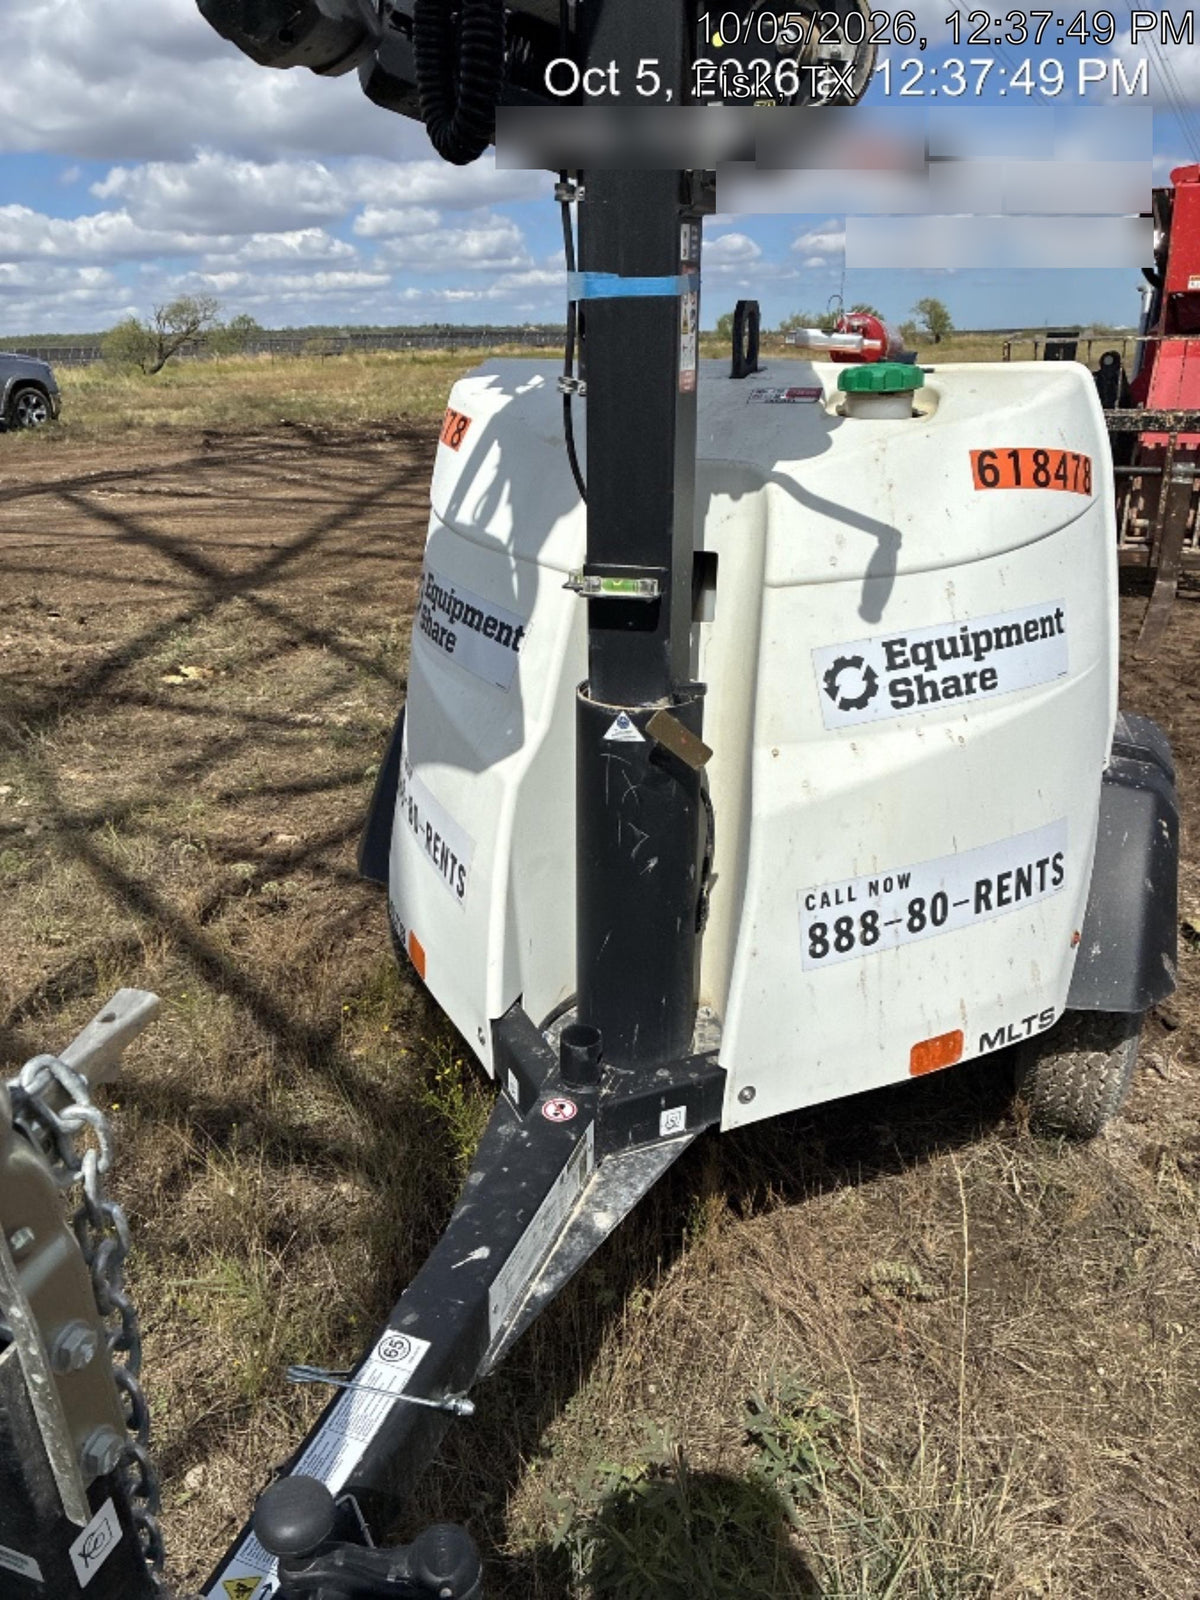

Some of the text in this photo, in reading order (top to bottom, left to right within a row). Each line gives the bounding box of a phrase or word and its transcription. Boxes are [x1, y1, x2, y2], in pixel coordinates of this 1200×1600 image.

[976, 449, 1092, 496] 618478
[423, 572, 525, 652] Equipment
[881, 607, 1065, 673] Equipment
[887, 665, 999, 710] Share
[804, 872, 912, 911] CALL NOW
[807, 851, 1065, 960] 888-80-RENTS
[978, 1005, 1056, 1053] MLTS
[383, 1338, 405, 1360] 65
